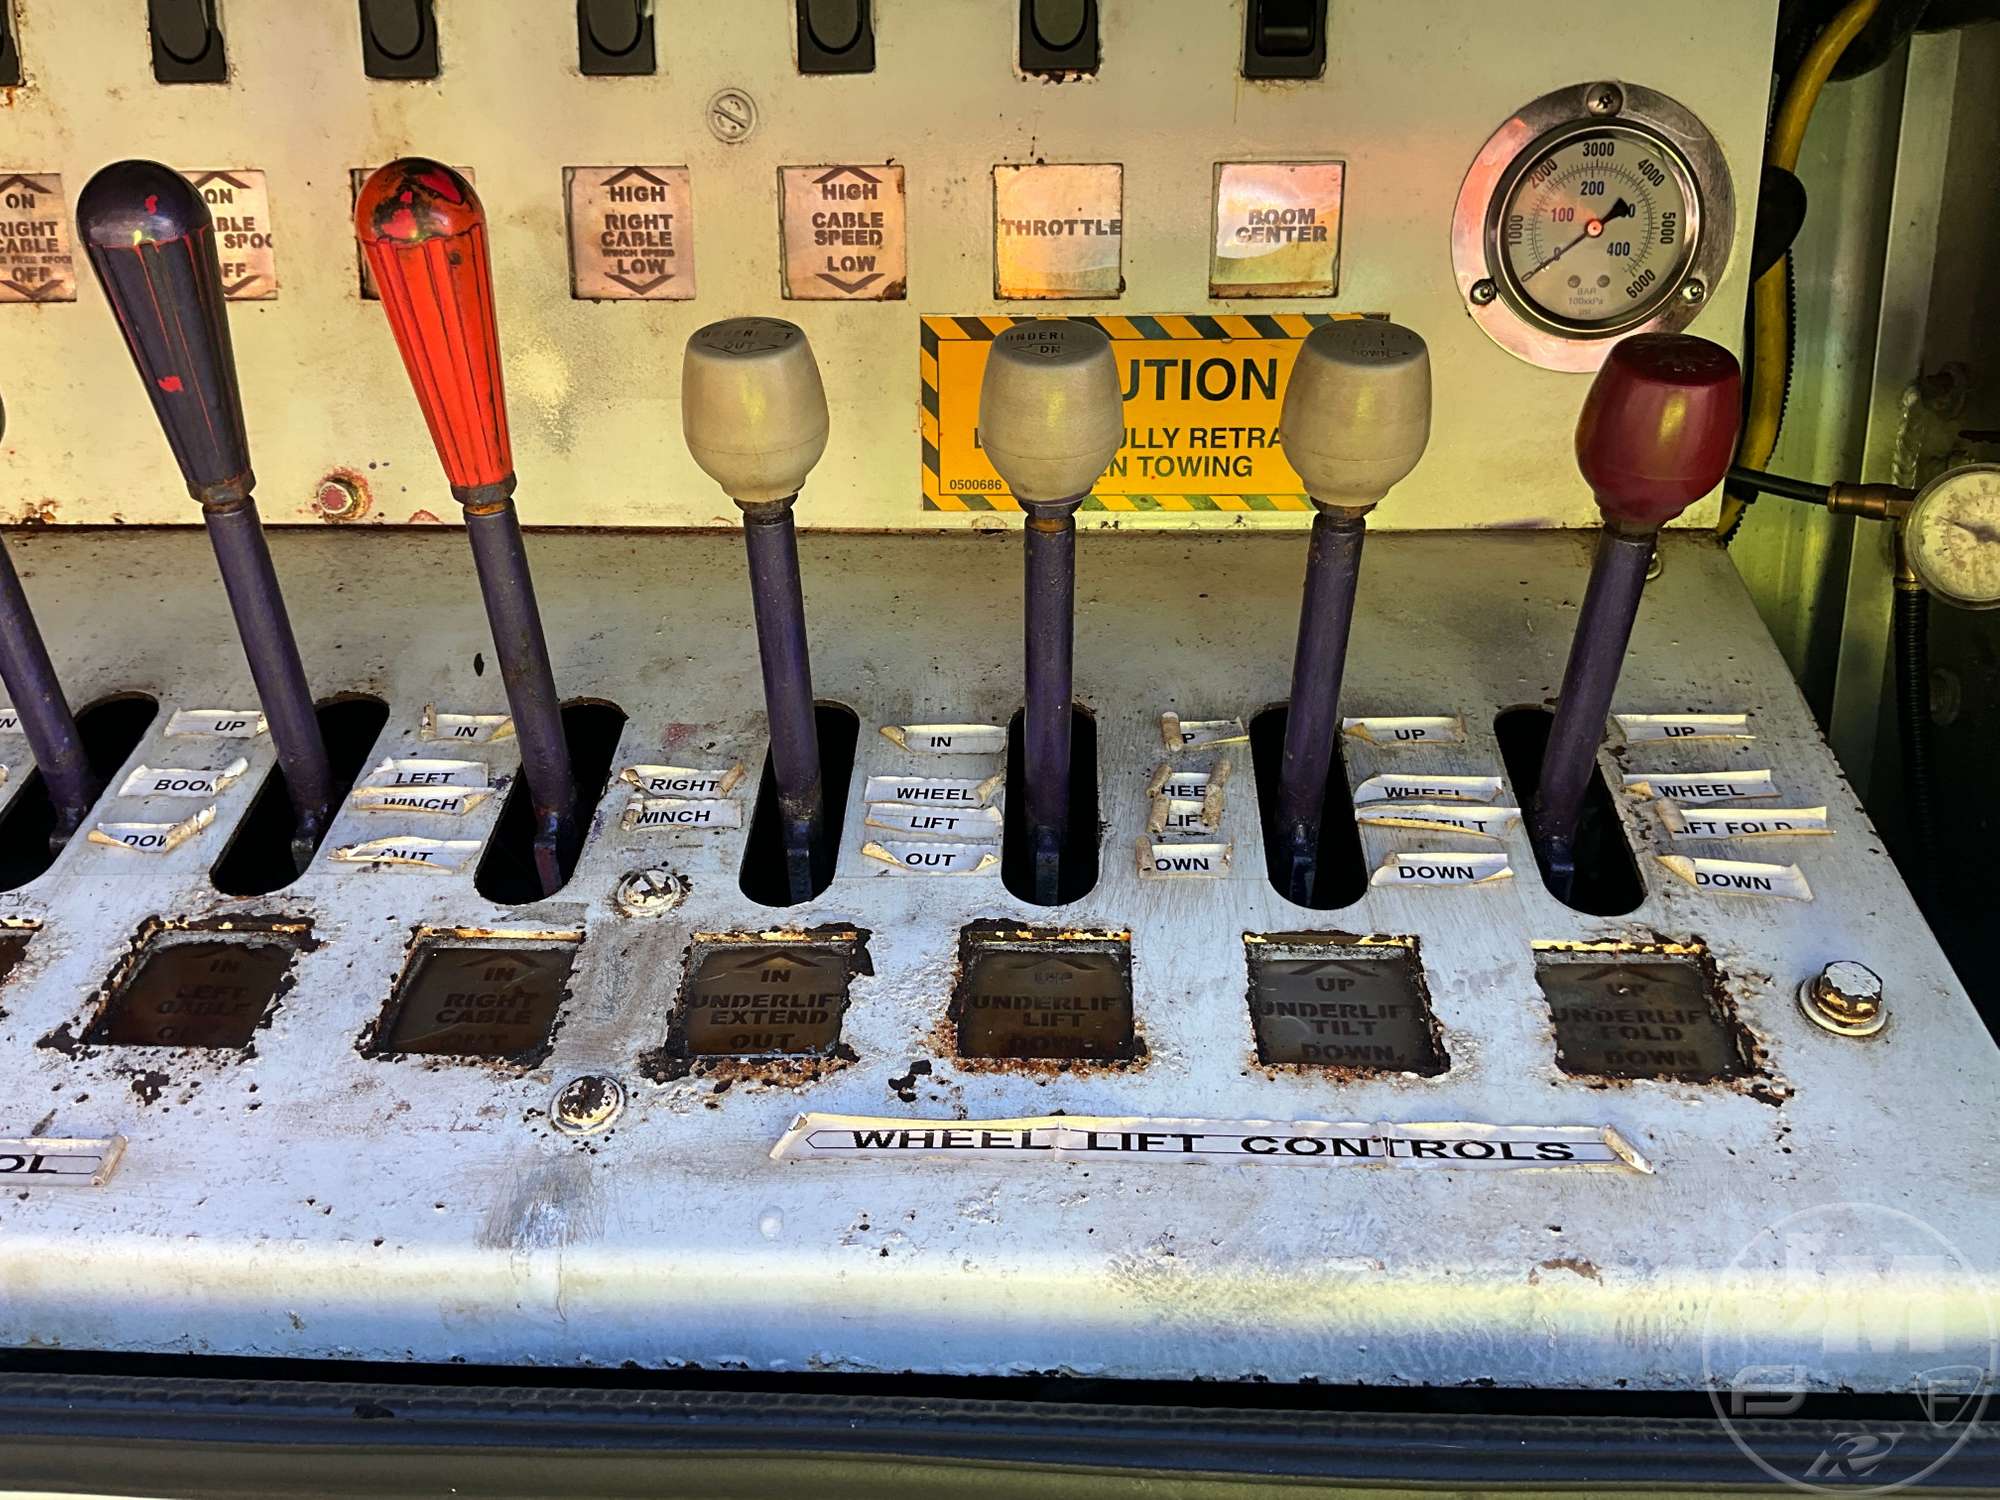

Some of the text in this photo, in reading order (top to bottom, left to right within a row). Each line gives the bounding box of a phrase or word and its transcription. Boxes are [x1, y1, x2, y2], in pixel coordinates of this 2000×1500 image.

[1583, 141, 1615, 157] 3000
[1528, 159, 1558, 189] 2000
[1638, 158, 1666, 188] 4000
[204, 188, 233, 204] ON
[610, 186, 666, 202] HIGH
[822, 184, 878, 200] HIGH
[1580, 181, 1605, 196] 200
[6, 193, 35, 209] ON
[605, 214, 674, 230] RIGHT
[812, 213, 884, 229] CABLE
[1248, 208, 1316, 225] BOOM
[1551, 207, 1575, 223] 100
[214, 217, 255, 232] BLE
[1002, 219, 1122, 236] THROTTLE
[1508, 214, 1524, 247] 1000
[1660, 211, 1676, 245] 5000
[601, 231, 673, 247] CABLE
[814, 230, 884, 246] SPEED
[1235, 226, 1328, 243] CENTER
[1607, 241, 1631, 257] 400
[222, 263, 246, 278] FF
[617, 259, 667, 274] LOW
[827, 256, 877, 272] LOW
[1625, 268, 1657, 300] 6000
[1121, 357, 1278, 402] UTION
[1120, 428, 1281, 449] LLY RETRA
[1137, 455, 1253, 477] TOWING
[949, 479, 1002, 490] 0500686
[214, 720, 247, 732] UP
[454, 726, 479, 738] IN
[1664, 726, 1696, 738] UP
[930, 736, 952, 748] IN
[1182, 733, 1196, 745] P
[1394, 728, 1426, 741] UP
[395, 772, 455, 785] LEFT
[650, 778, 720, 792] RIGHT
[896, 787, 975, 801] WHEEL
[1161, 785, 1207, 797] HEE
[1658, 784, 1745, 798] WHEEL
[635, 810, 711, 824] WINCH
[910, 816, 960, 830] LIFT
[1165, 813, 1203, 827] LIF
[123, 834, 167, 847] DO
[905, 853, 957, 867] OUT
[1155, 858, 1210, 871] OWN
[1398, 865, 1475, 880] DOWN
[1695, 872, 1772, 891] DOWN
[484, 967, 517, 982] IN
[760, 969, 791, 983] IN
[1315, 977, 1356, 993] UP
[443, 992, 540, 1009] RIGHT
[688, 992, 840, 1009] UNDERLIF
[973, 994, 1118, 1011] UNDERLIF
[435, 1009, 532, 1025] CABLE
[710, 1010, 830, 1025] EXTEND
[1258, 1000, 1410, 1019] UNDERLIF
[1551, 1007, 1703, 1025] UNDERLIF
[1023, 1012, 1086, 1028] LIFT
[1309, 1019, 1378, 1036] TILT
[729, 1033, 796, 1049] OUT
[1301, 1042, 1394, 1061] DOWN
[852, 1128, 1575, 1161] WHEEL LIFT CONTROLS
[0, 1154, 58, 1174] OL
